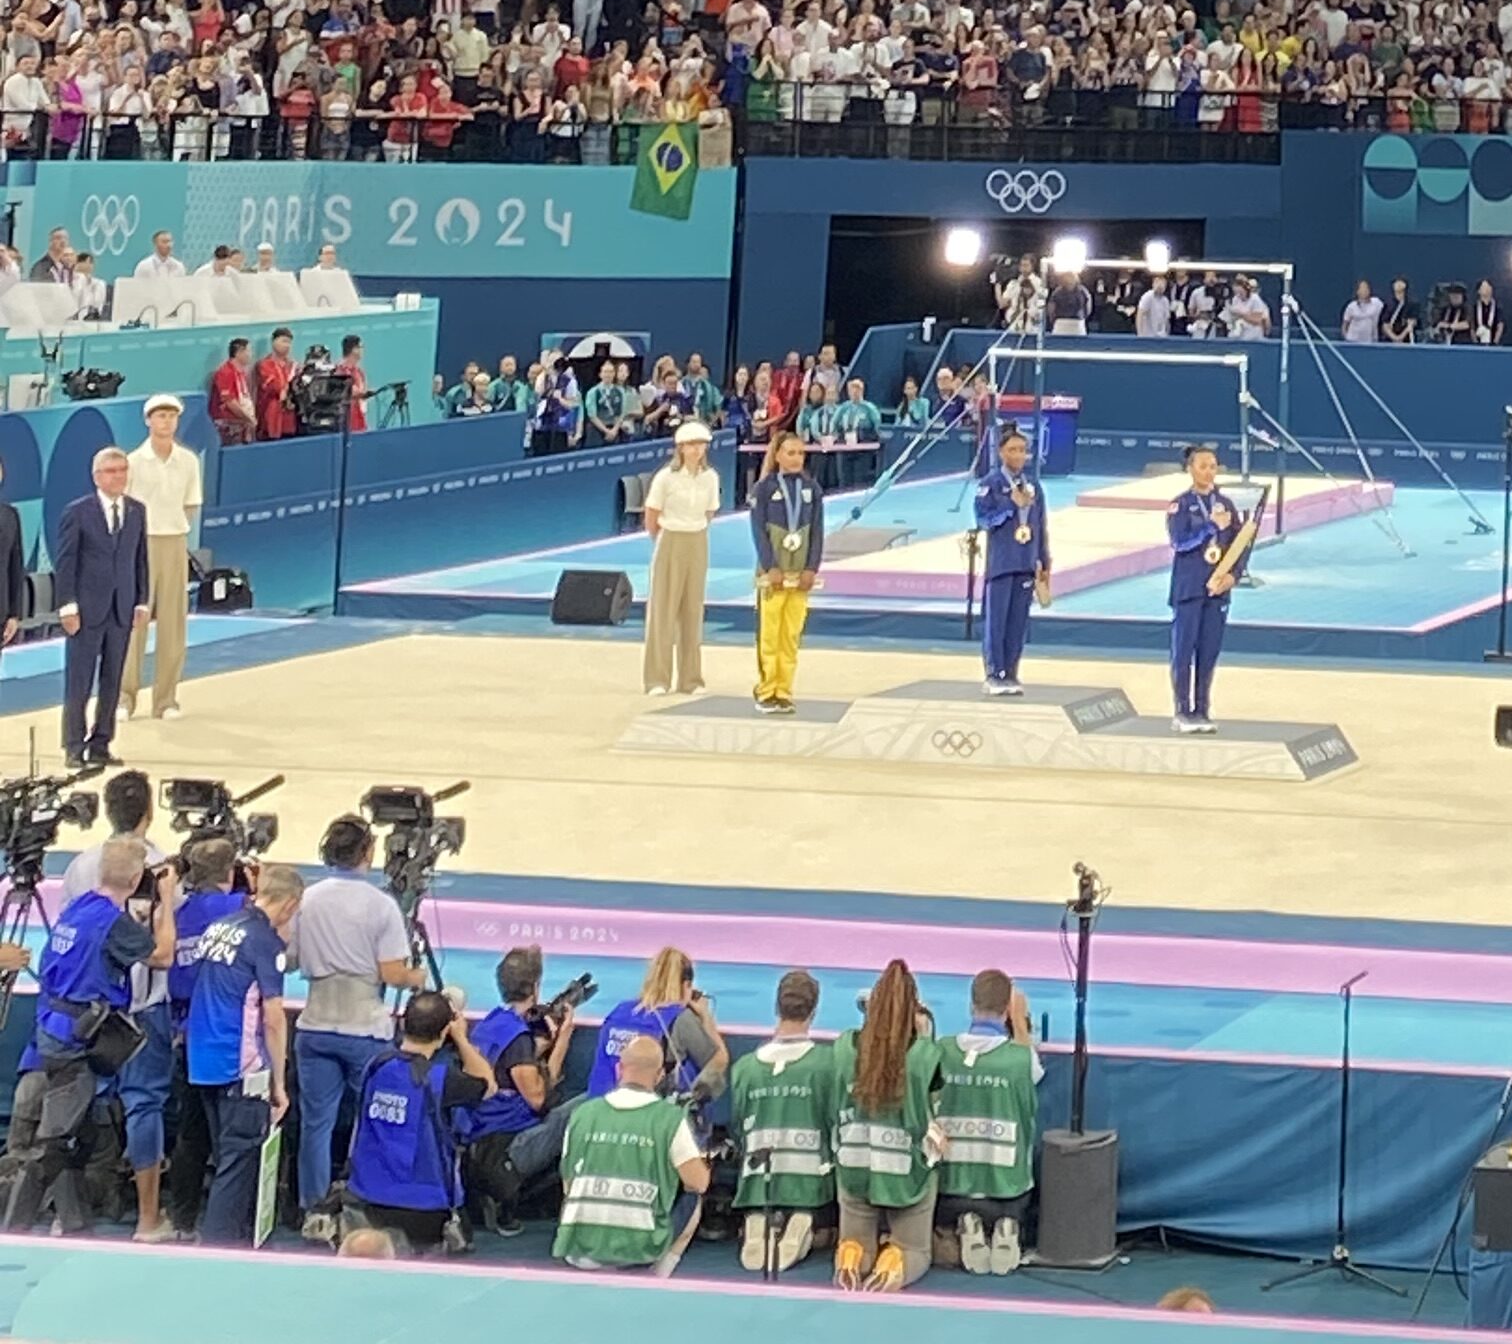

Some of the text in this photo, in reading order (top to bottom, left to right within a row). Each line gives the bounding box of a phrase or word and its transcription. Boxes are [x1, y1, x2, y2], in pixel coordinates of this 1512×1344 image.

[239, 194, 572, 247] PARIS 2024
[509, 922, 619, 943] PARIS 2024
